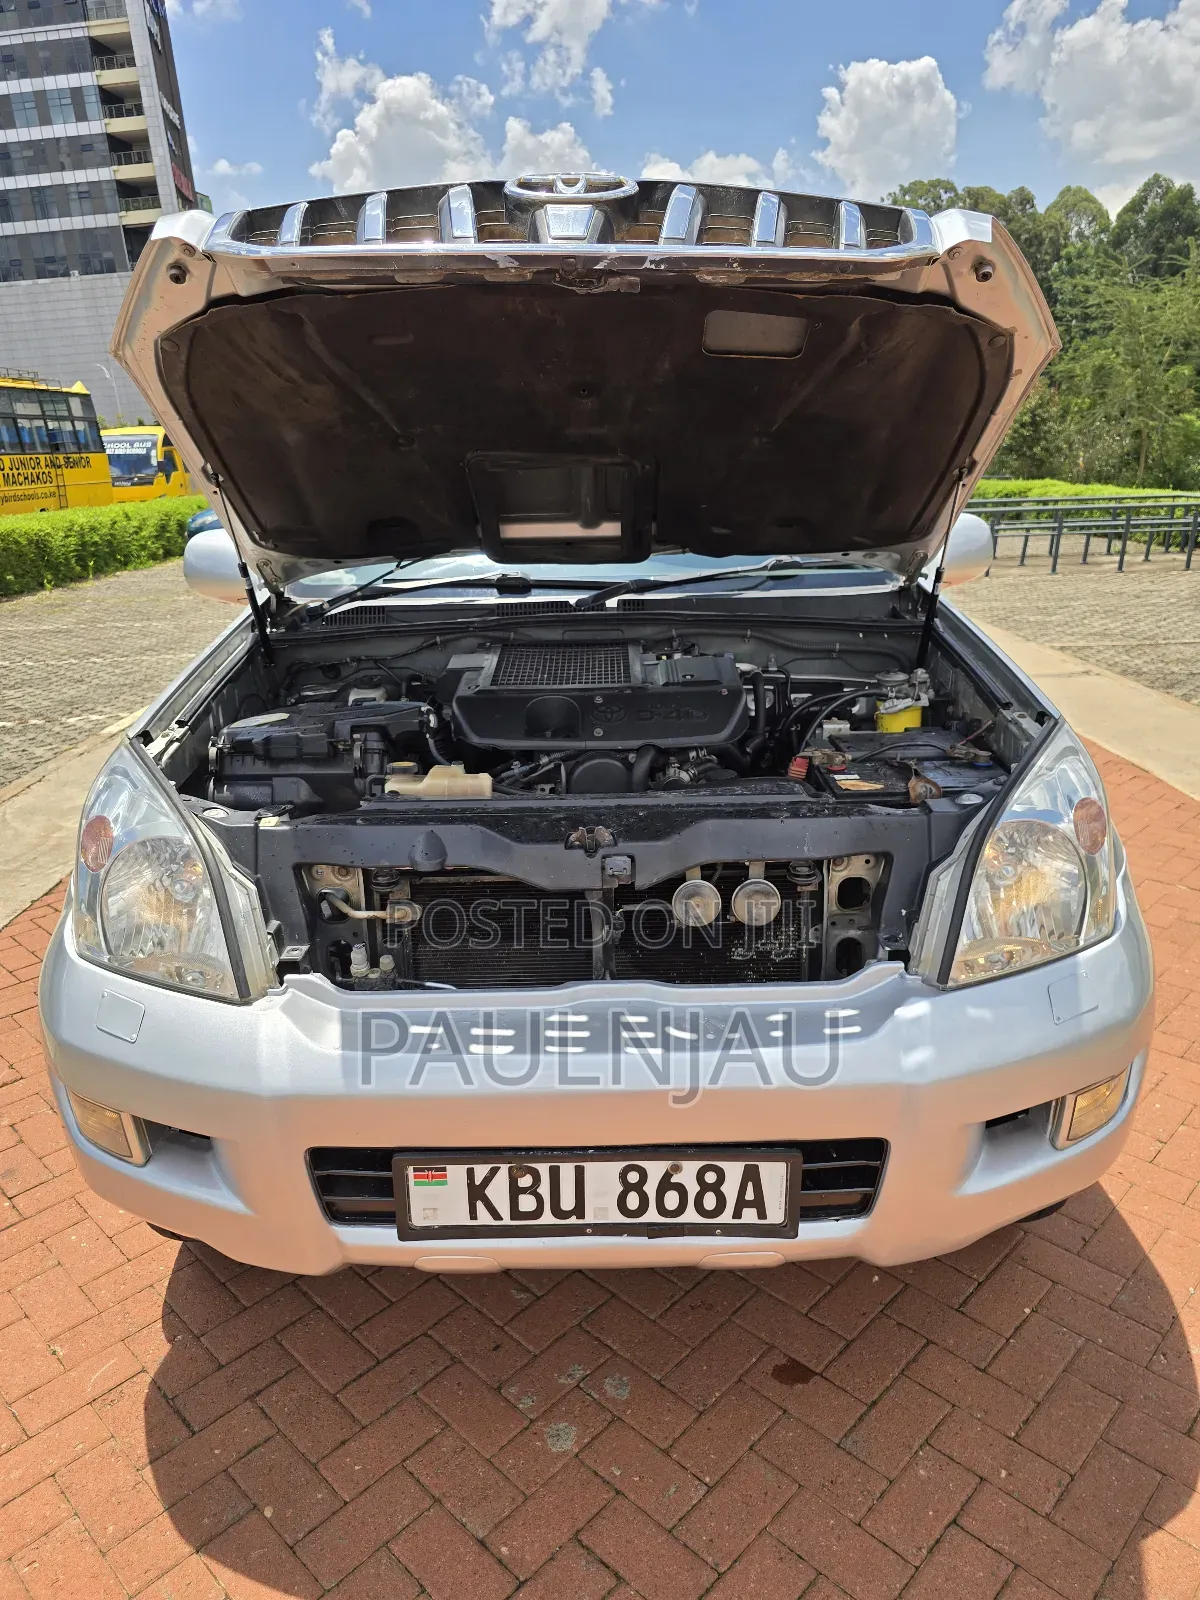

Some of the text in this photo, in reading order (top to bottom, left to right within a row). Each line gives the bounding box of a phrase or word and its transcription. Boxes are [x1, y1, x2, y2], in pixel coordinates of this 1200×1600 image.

[8, 456, 43, 471] JUNIOR
[44, 455, 61, 469] AND
[62, 455, 92, 469] SENIOR
[2, 471, 54, 487] MACHAKOS
[466, 1164, 586, 1221] KBU
[616, 1163, 768, 1220] 868A
